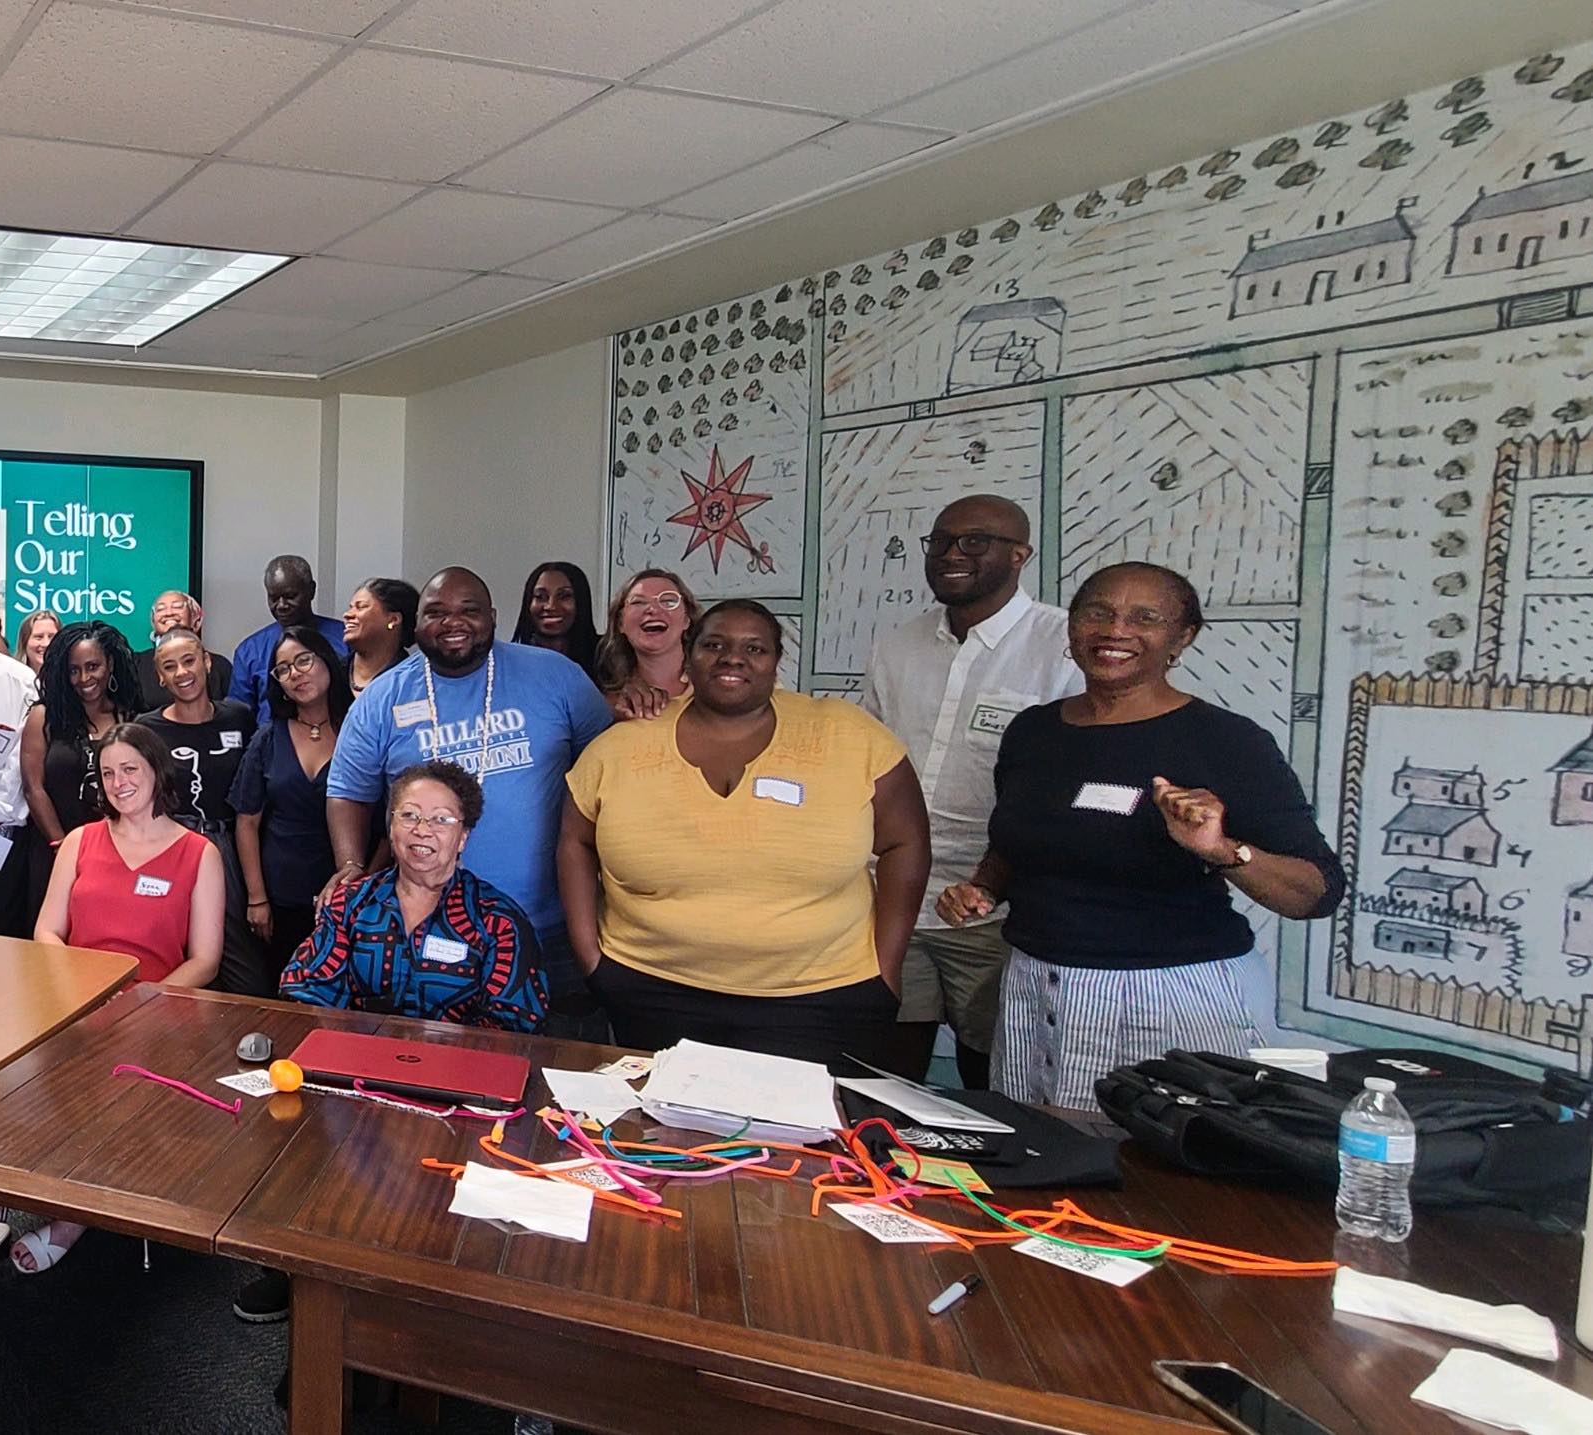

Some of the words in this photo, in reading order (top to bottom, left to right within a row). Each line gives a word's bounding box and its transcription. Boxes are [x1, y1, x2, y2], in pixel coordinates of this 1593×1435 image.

[994, 278, 1020, 299] 13
[15, 500, 137, 550] Telling
[14, 540, 84, 575] Our
[14, 579, 135, 615] Stories
[415, 708, 526, 753] DILLARD
[422, 730, 527, 758] UIVERSITY
[440, 741, 534, 775] UMNI
[1493, 778, 1528, 801] 5
[1506, 842, 1532, 868] 4
[1499, 888, 1531, 911] 6
